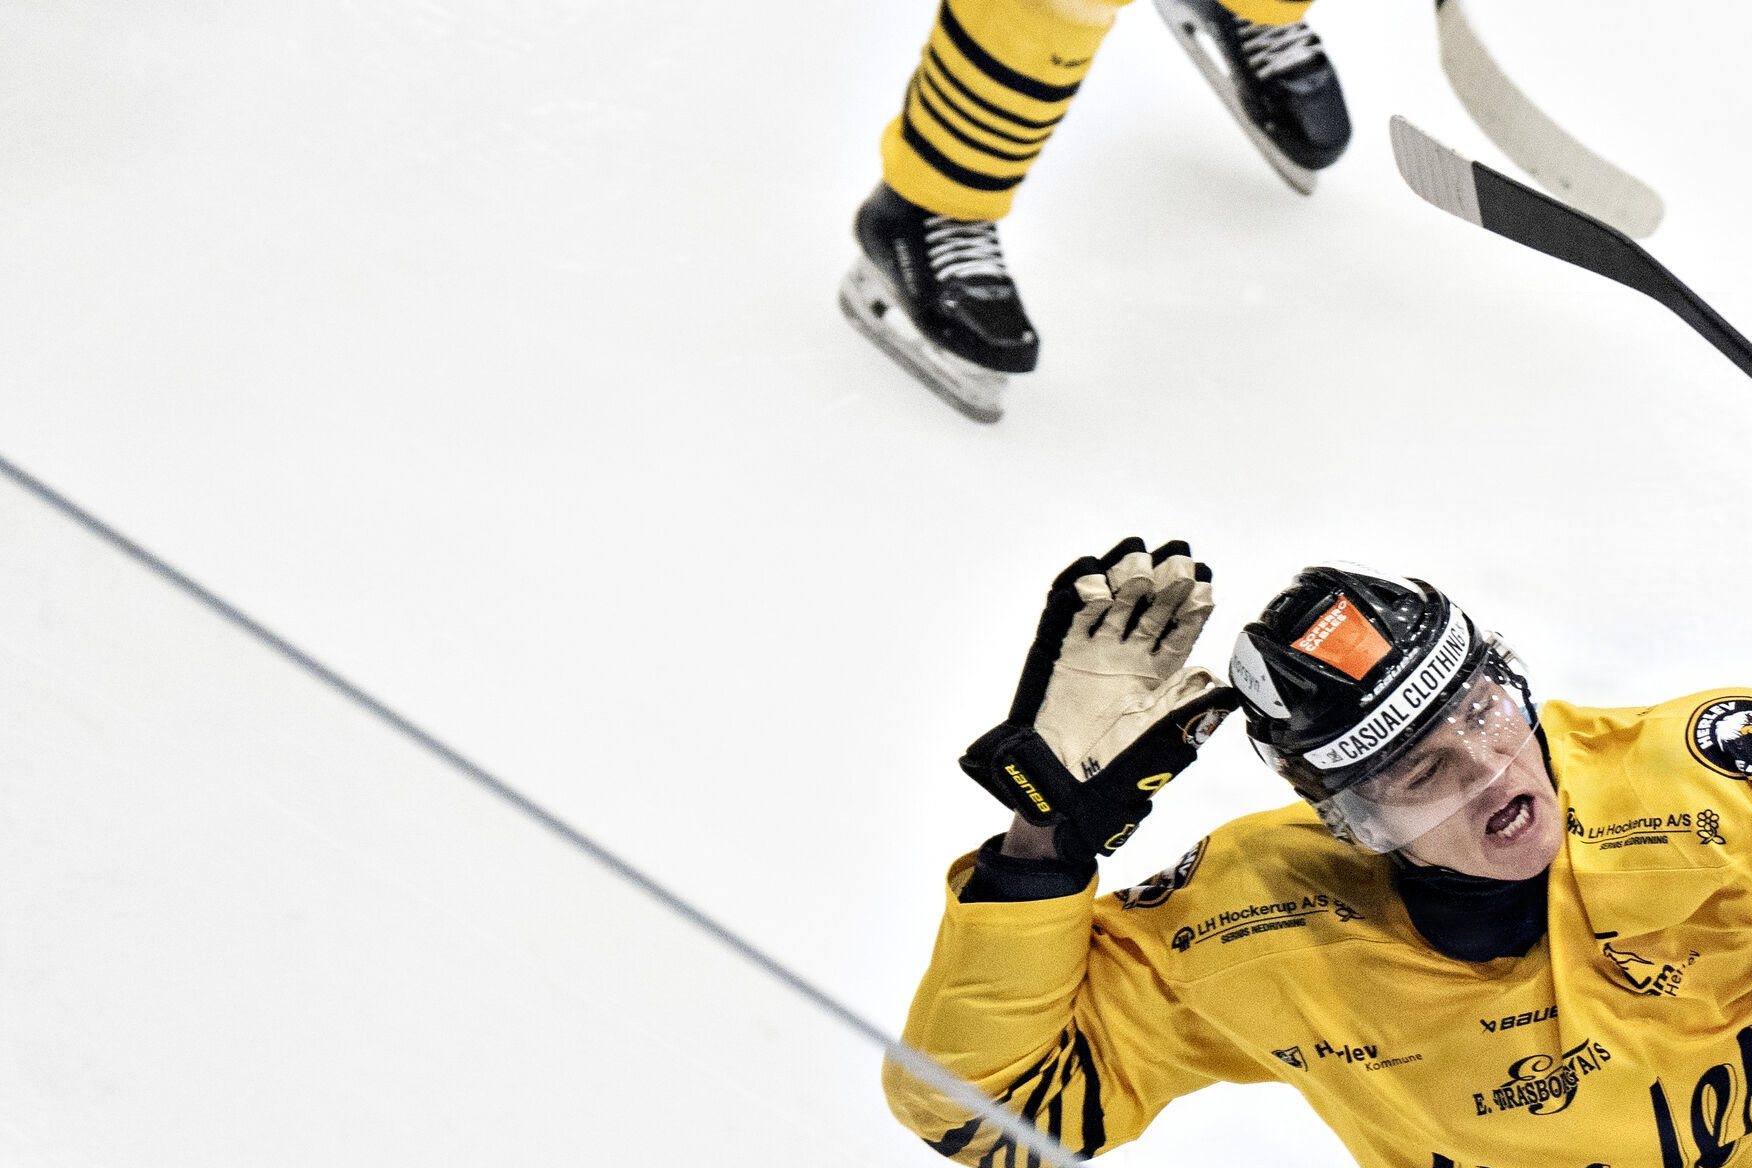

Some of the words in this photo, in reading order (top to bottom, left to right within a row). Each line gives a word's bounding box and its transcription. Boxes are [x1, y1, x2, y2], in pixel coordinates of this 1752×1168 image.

[1299, 600, 1347, 648] COFERRO
[1305, 614, 1347, 652] CABLES
[1338, 704, 1410, 759] CASUAL
[1402, 627, 1466, 709] CLOTHING
[1696, 701, 1737, 750] HERLEV
[1005, 764, 1051, 812] BAUER
[1588, 826, 1605, 839] LH
[1667, 813, 1692, 827] A/S
[1197, 918, 1217, 936] LH
[1219, 901, 1297, 926] Hockerup
[1302, 894, 1329, 909] A/S
[1664, 950, 1700, 997] Herev
[1500, 1005, 1558, 1031] BAUE
[1315, 1040, 1378, 1064] Hlev
[1365, 1053, 1423, 1072] Kommune
[1577, 1042, 1611, 1075] A/S
